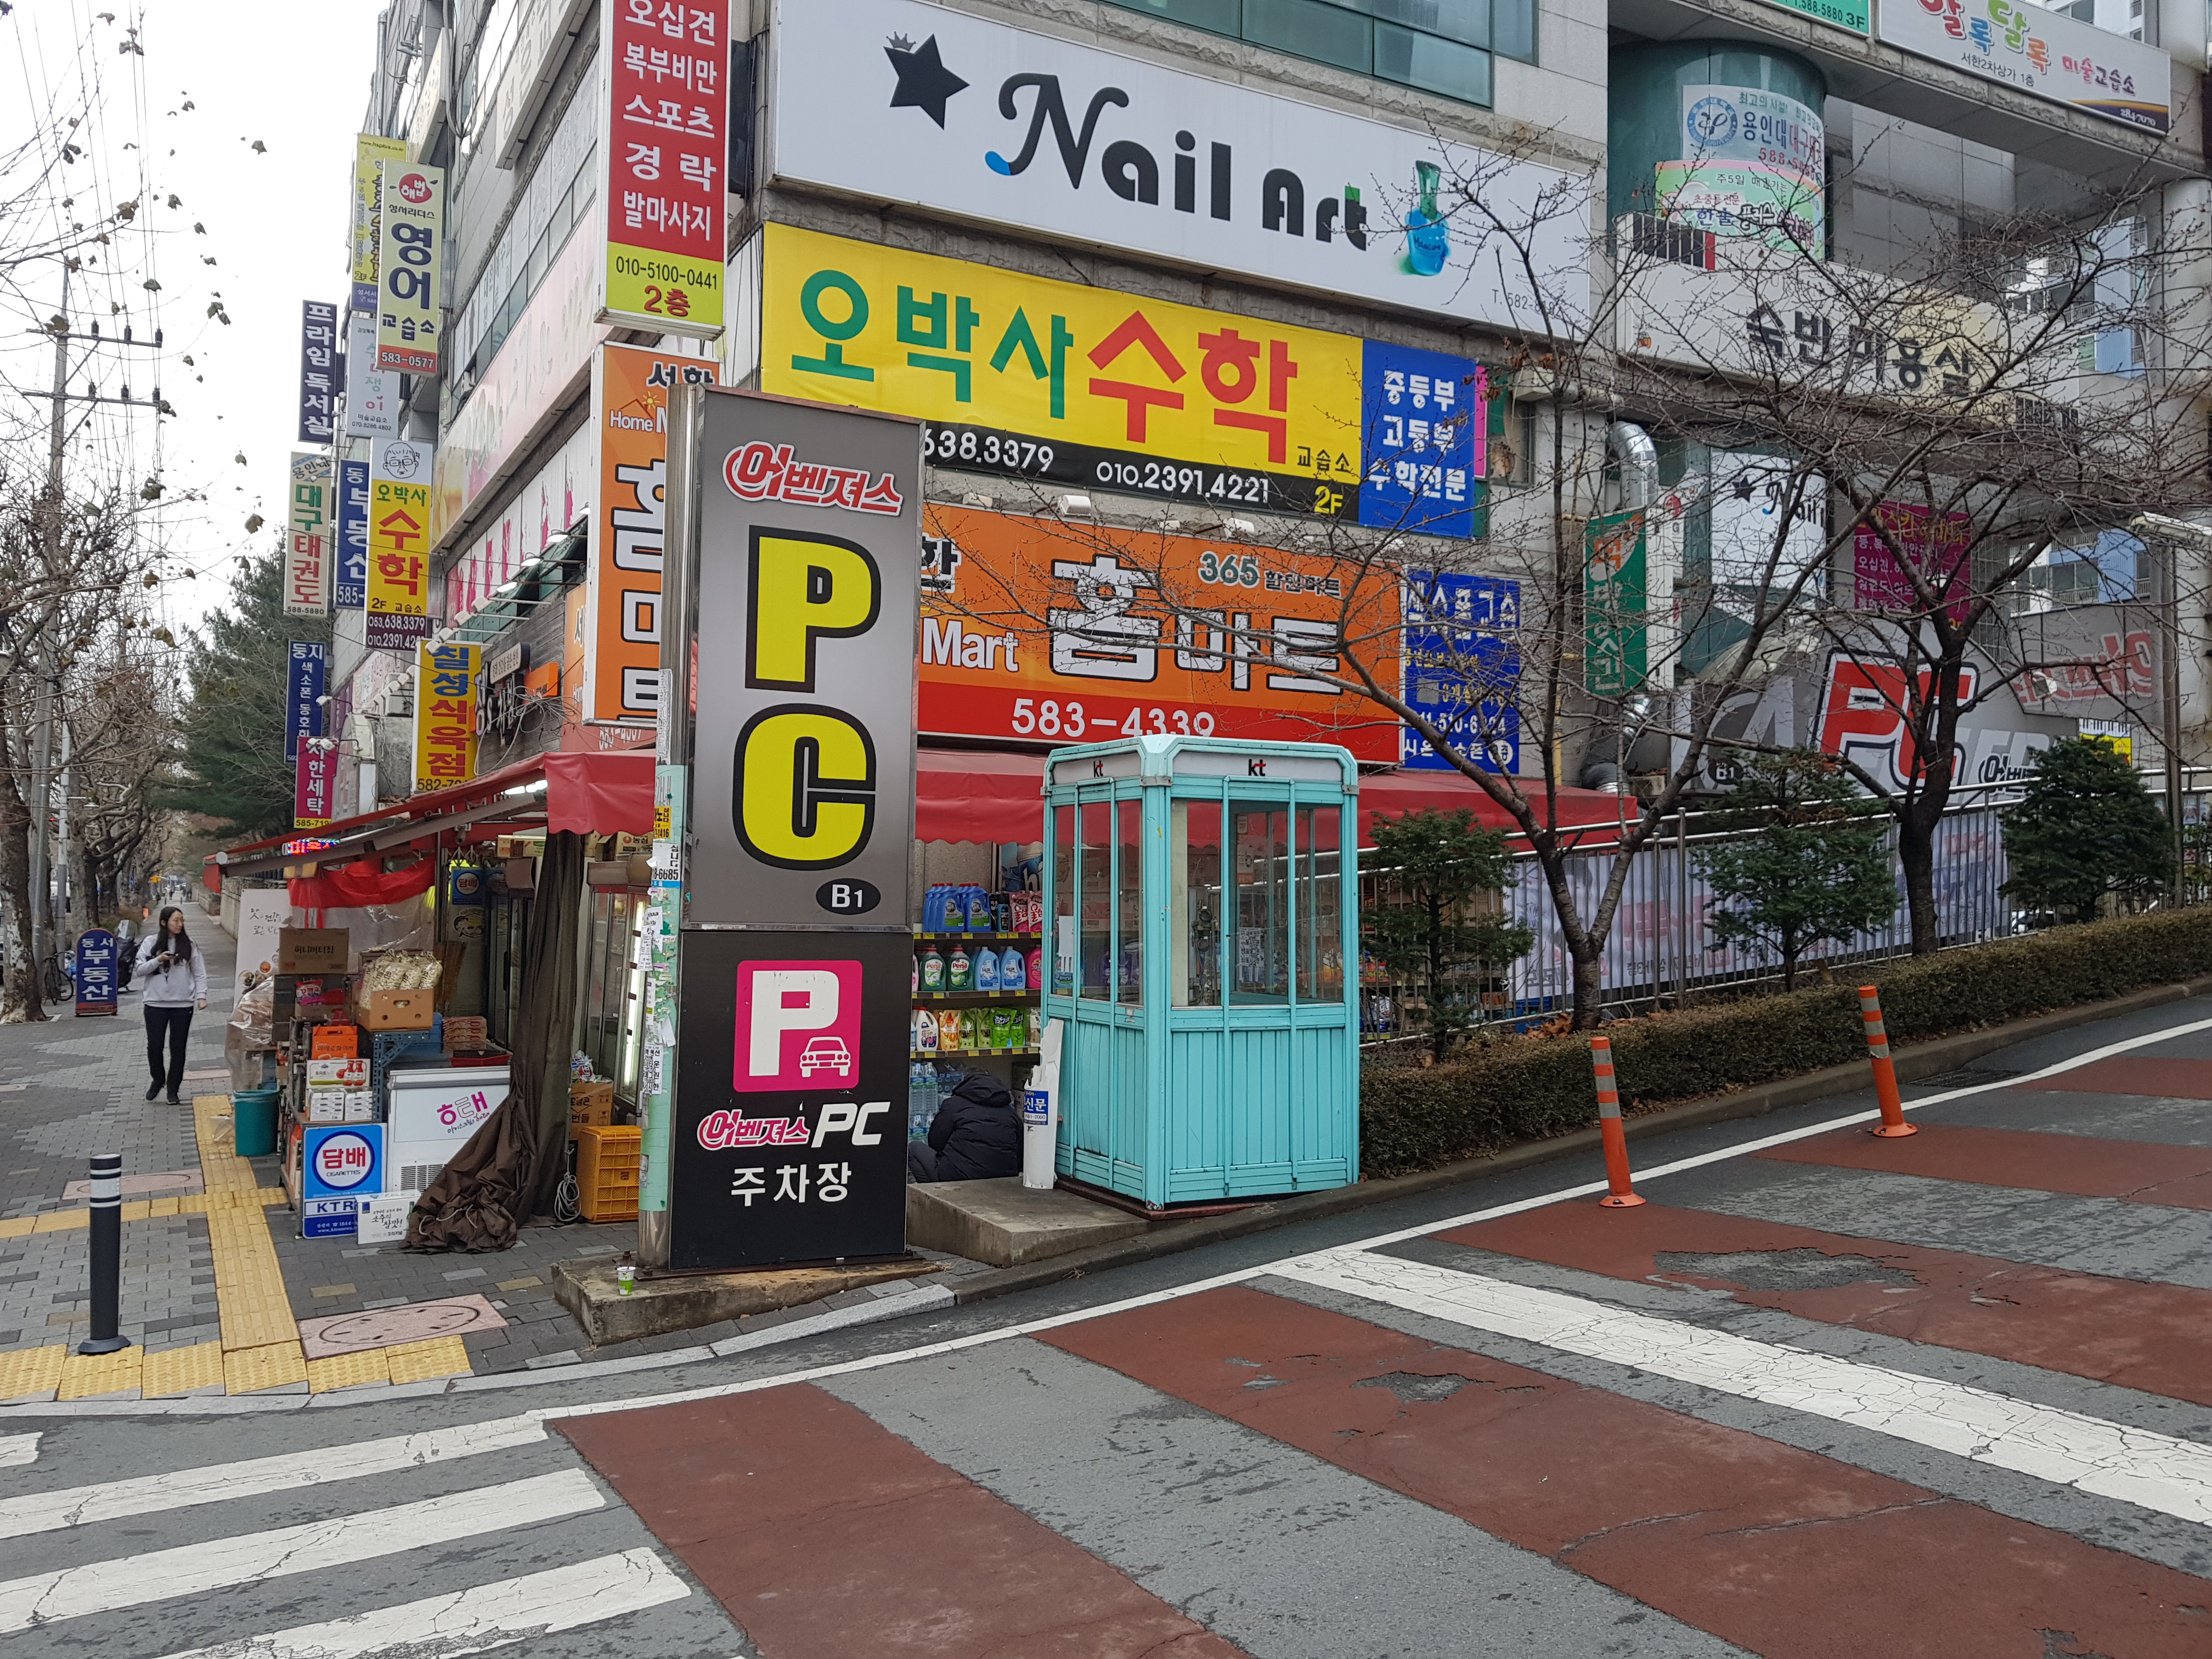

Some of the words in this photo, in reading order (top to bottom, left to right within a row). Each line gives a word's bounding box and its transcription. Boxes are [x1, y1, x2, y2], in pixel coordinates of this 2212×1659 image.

[624, 0, 715, 46] 오십견
[1846, 13, 1865, 28] 3F
[623, 41, 717, 95] 복부비만
[2020, 74, 2035, 87] 1층
[2062, 55, 2137, 97] 미술교습소
[623, 94, 715, 138] 스포츠
[985, 72, 1231, 222] Nail
[1262, 168, 1368, 251] Art
[388, 204, 436, 219] 성서리더스
[623, 190, 711, 240] 발마사지
[354, 271, 367, 281] 2F
[388, 222, 432, 311] 영어
[616, 256, 718, 290] 010-5100-0441
[644, 285, 691, 317] 2층
[305, 304, 334, 367] 프라임
[382, 313, 435, 341] 교습소
[381, 352, 435, 369] 583-0577
[791, 269, 1074, 420] 오박사
[1086, 309, 1299, 465] 수학
[303, 371, 334, 436] 독서실
[1384, 369, 1455, 411] 중등부
[610, 410, 653, 433] Home
[1383, 414, 1455, 455] 고등부
[1297, 445, 1350, 471] 교습소
[376, 483, 426, 507] 오박사
[722, 440, 905, 517] 어벤져스
[1097, 461, 1269, 504] 010.2391.4221
[1313, 486, 1344, 514] 2F
[377, 509, 422, 596] 수학
[1198, 551, 1260, 588] 365
[286, 606, 325, 615] 588-5880
[368, 614, 425, 633] 053.638.3379
[371, 598, 387, 609] 2F
[394, 602, 422, 614] 교습소
[1046, 554, 1344, 696] 홈마트
[292, 643, 323, 660] 둥지
[922, 617, 1019, 673] Mart
[300, 662, 313, 699] 색소폰
[732, 524, 882, 871] PC
[1011, 697, 1216, 739] 583-4339
[1093, 760, 1103, 777] kt
[1248, 759, 1267, 777] kt
[633, 836, 648, 844] 농심
[458, 878, 477, 888] 담배
[830, 884, 864, 908] B1
[81, 936, 114, 948] 동서
[81, 949, 112, 1001] 부동산
[749, 970, 839, 1077] P
[1024, 1097, 1047, 1112] 신문
[696, 1109, 810, 1150] 어벤져스
[811, 1101, 891, 1148] PC
[323, 1146, 366, 1170] 담배
[731, 1161, 852, 1206] 주차장
[317, 1200, 356, 1214] KTR
